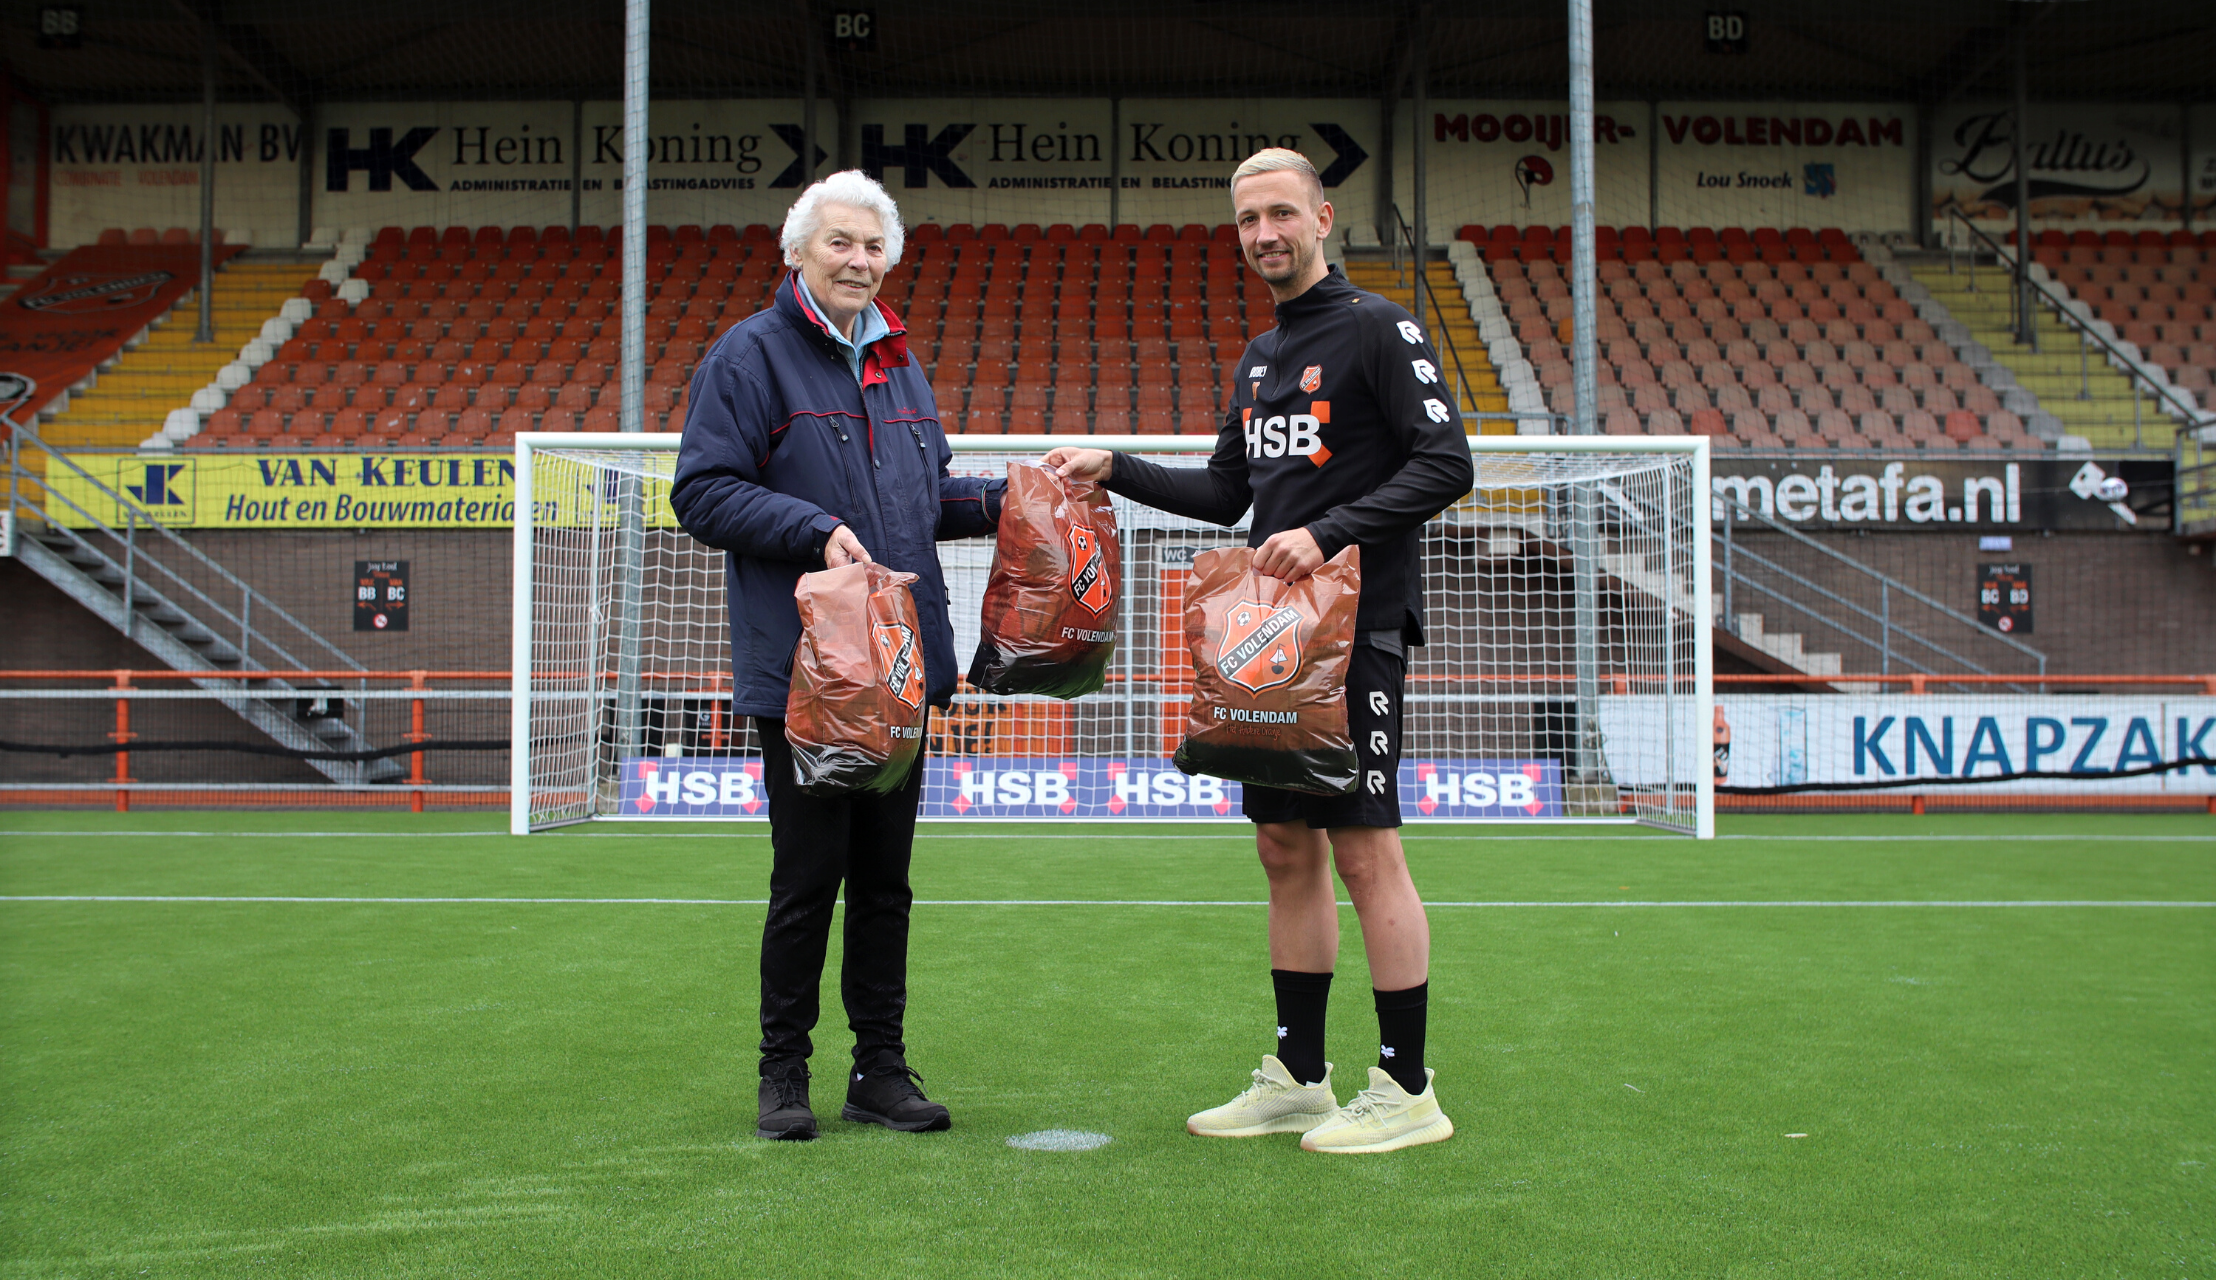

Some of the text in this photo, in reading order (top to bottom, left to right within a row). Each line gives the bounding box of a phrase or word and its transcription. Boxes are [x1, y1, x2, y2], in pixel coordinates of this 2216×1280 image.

[835, 13, 870, 38] BC
[1707, 15, 1744, 40] BD
[452, 125, 564, 164] Hein
[988, 122, 1101, 162] Hein
[1662, 115, 1903, 146] VOLENDAM
[327, 127, 440, 191] HK
[862, 124, 977, 188] HK
[450, 179, 571, 191] ADMINISTRATIE
[583, 179, 602, 190] EN
[988, 177, 1112, 189] ADMINISTRATIE
[1121, 177, 1140, 188] EN
[1697, 171, 1793, 188] Lou Snoek
[1244, 414, 1322, 459] HSB
[257, 457, 516, 486] VAN KEULEN
[1711, 462, 2021, 523] metafa.nl
[226, 494, 559, 521] Hout en Bouwmateriaen
[1163, 549, 1187, 561] WC
[358, 586, 405, 600] BB BC
[1073, 578, 1086, 597] FC
[1061, 626, 1075, 639] FC
[1220, 609, 1299, 675] FC VOLENDAM
[889, 676, 902, 695] FC
[1213, 706, 1298, 724] FC VOLENDAM
[890, 725, 901, 738] FC
[646, 771, 755, 805] HSB
[962, 771, 1070, 805] HSB
[1115, 772, 1224, 806] HSB
[1426, 772, 1536, 807] HSB
